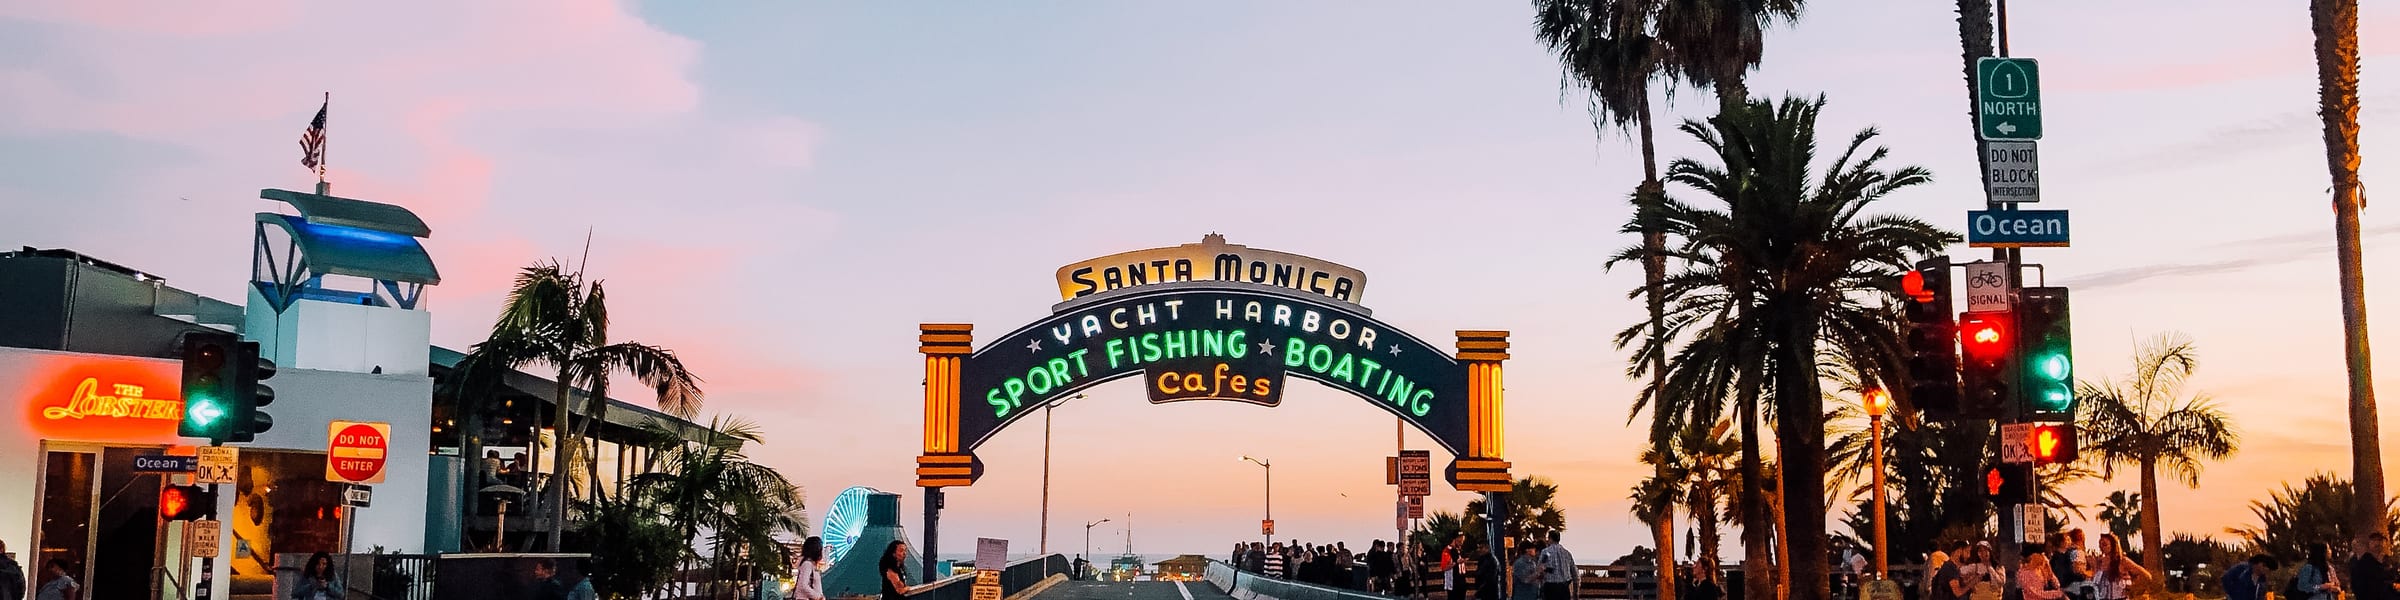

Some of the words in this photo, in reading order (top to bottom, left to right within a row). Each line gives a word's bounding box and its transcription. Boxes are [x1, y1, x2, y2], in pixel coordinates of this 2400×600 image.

[2006, 73, 2012, 91] 1
[1984, 101, 2036, 116] NORTH
[1991, 149, 2007, 163] DO
[2011, 149, 2033, 163] NOT
[1992, 169, 2035, 183] BLOCK
[1992, 186, 2036, 196] INTERSECTION
[1976, 214, 2062, 236] Ocean
[1071, 258, 1193, 298] SANTA
[1214, 253, 1354, 302] MONICA
[1970, 294, 2005, 305] SIGNAL
[1052, 299, 1184, 346] YACHT
[1215, 299, 1378, 352] HARBOR
[986, 348, 1089, 418] SPORT
[1106, 329, 1248, 369] FISHING
[1285, 337, 1435, 417] BOATING
[1157, 363, 1272, 398] cafes
[113, 383, 144, 398] THE
[340, 434, 354, 445] DO
[359, 435, 380, 446] NOT
[2004, 444, 2016, 459] OK
[136, 457, 179, 469] Ocean
[341, 460, 374, 472] ENTER
[199, 465, 213, 480] OK
